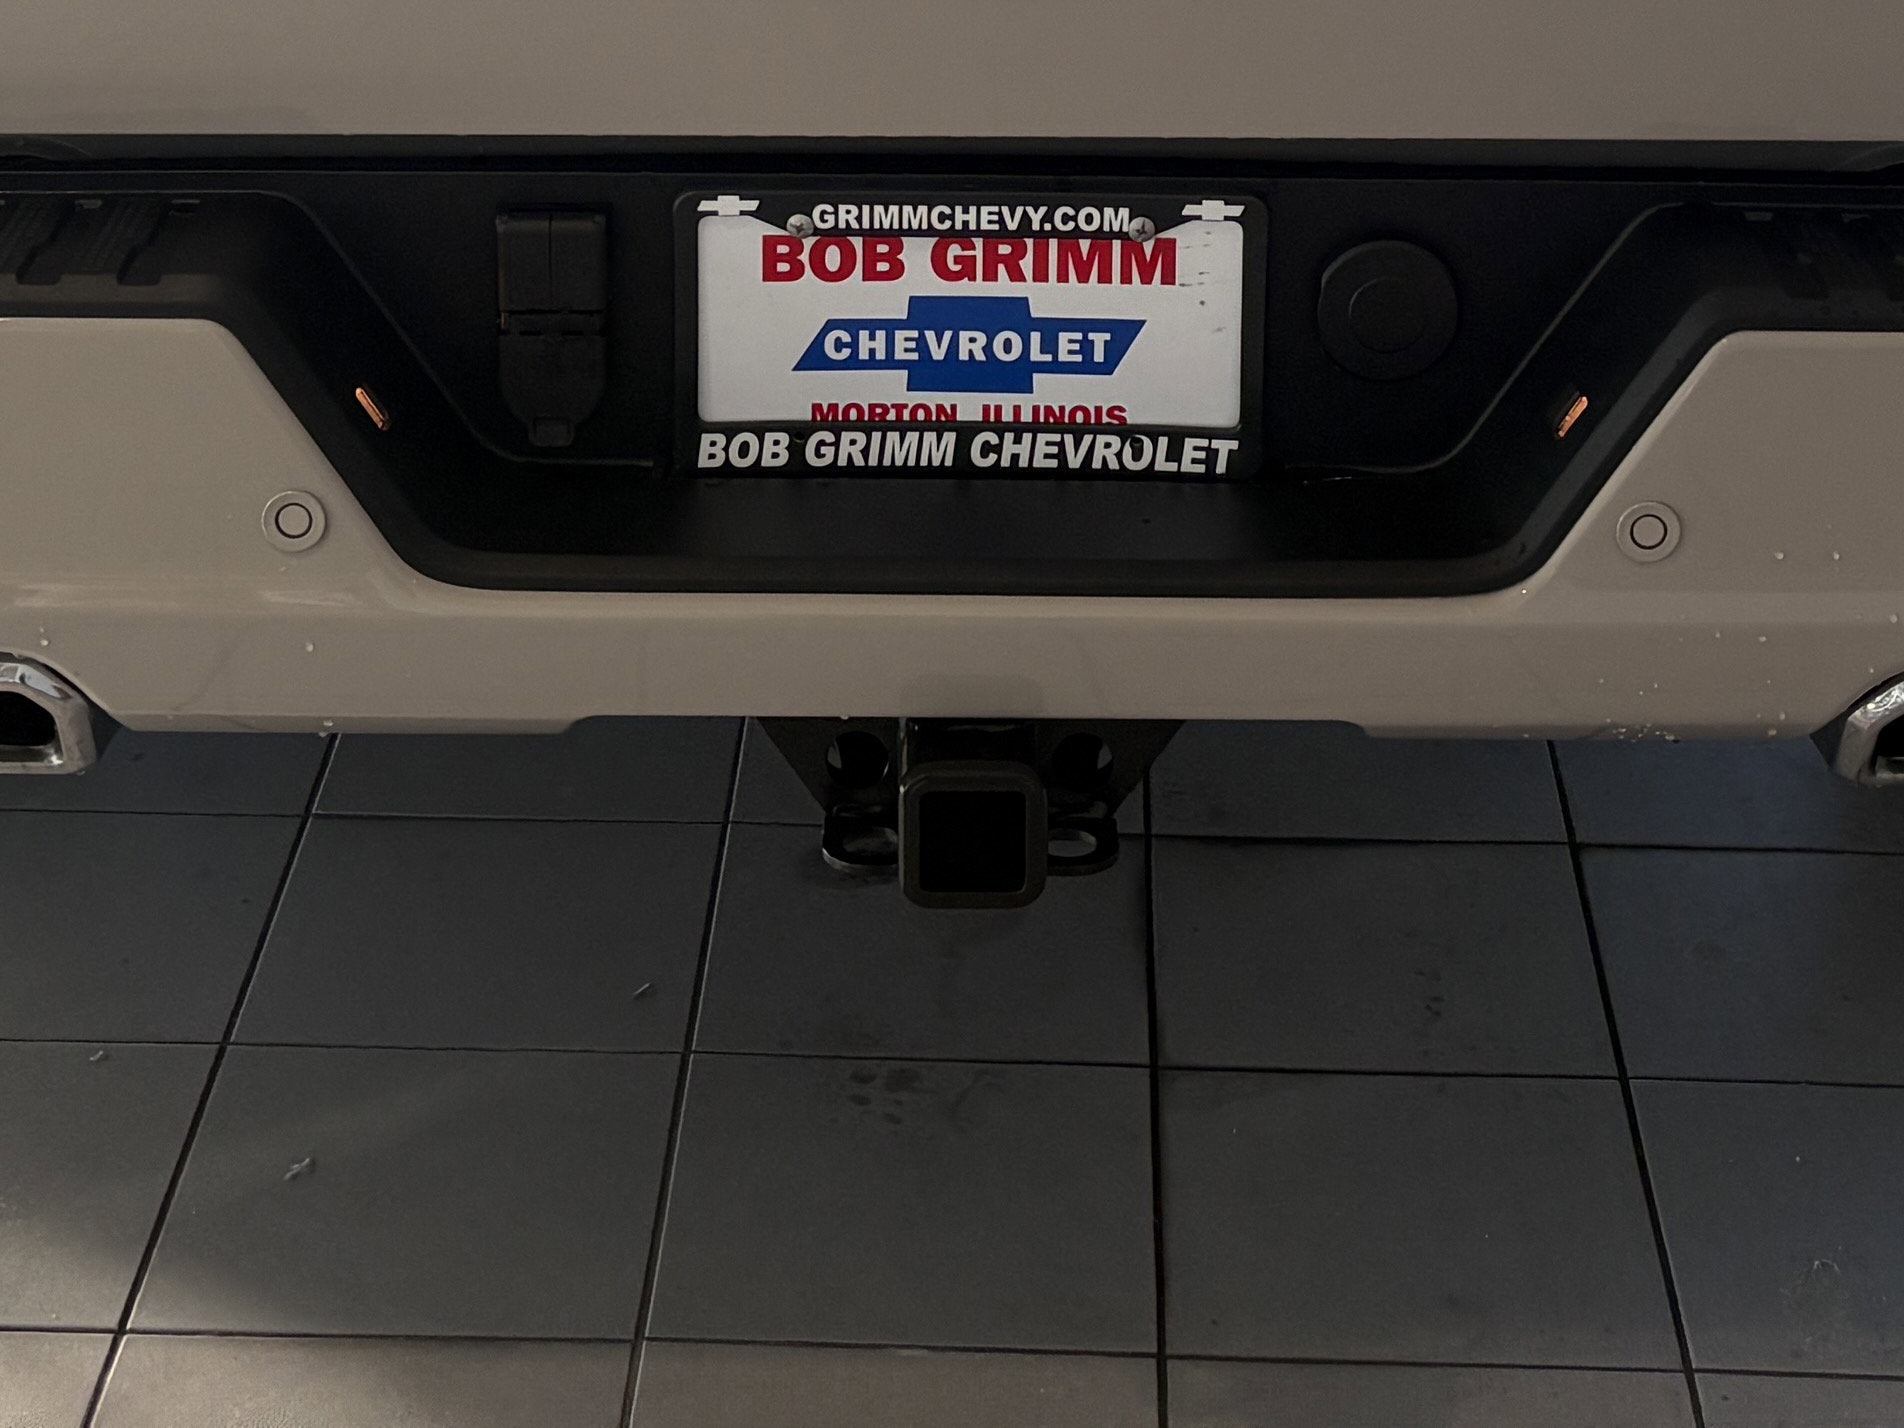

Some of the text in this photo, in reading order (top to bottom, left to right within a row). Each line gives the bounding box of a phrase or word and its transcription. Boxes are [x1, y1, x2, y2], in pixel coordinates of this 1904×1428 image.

[811, 202, 1132, 233] GRIMMCHEVY.COM
[762, 234, 1177, 286] BOB GRIMM
[823, 329, 1113, 363] CHEVROLET
[698, 431, 1239, 474] BOB GRIMM CHEVROLET
